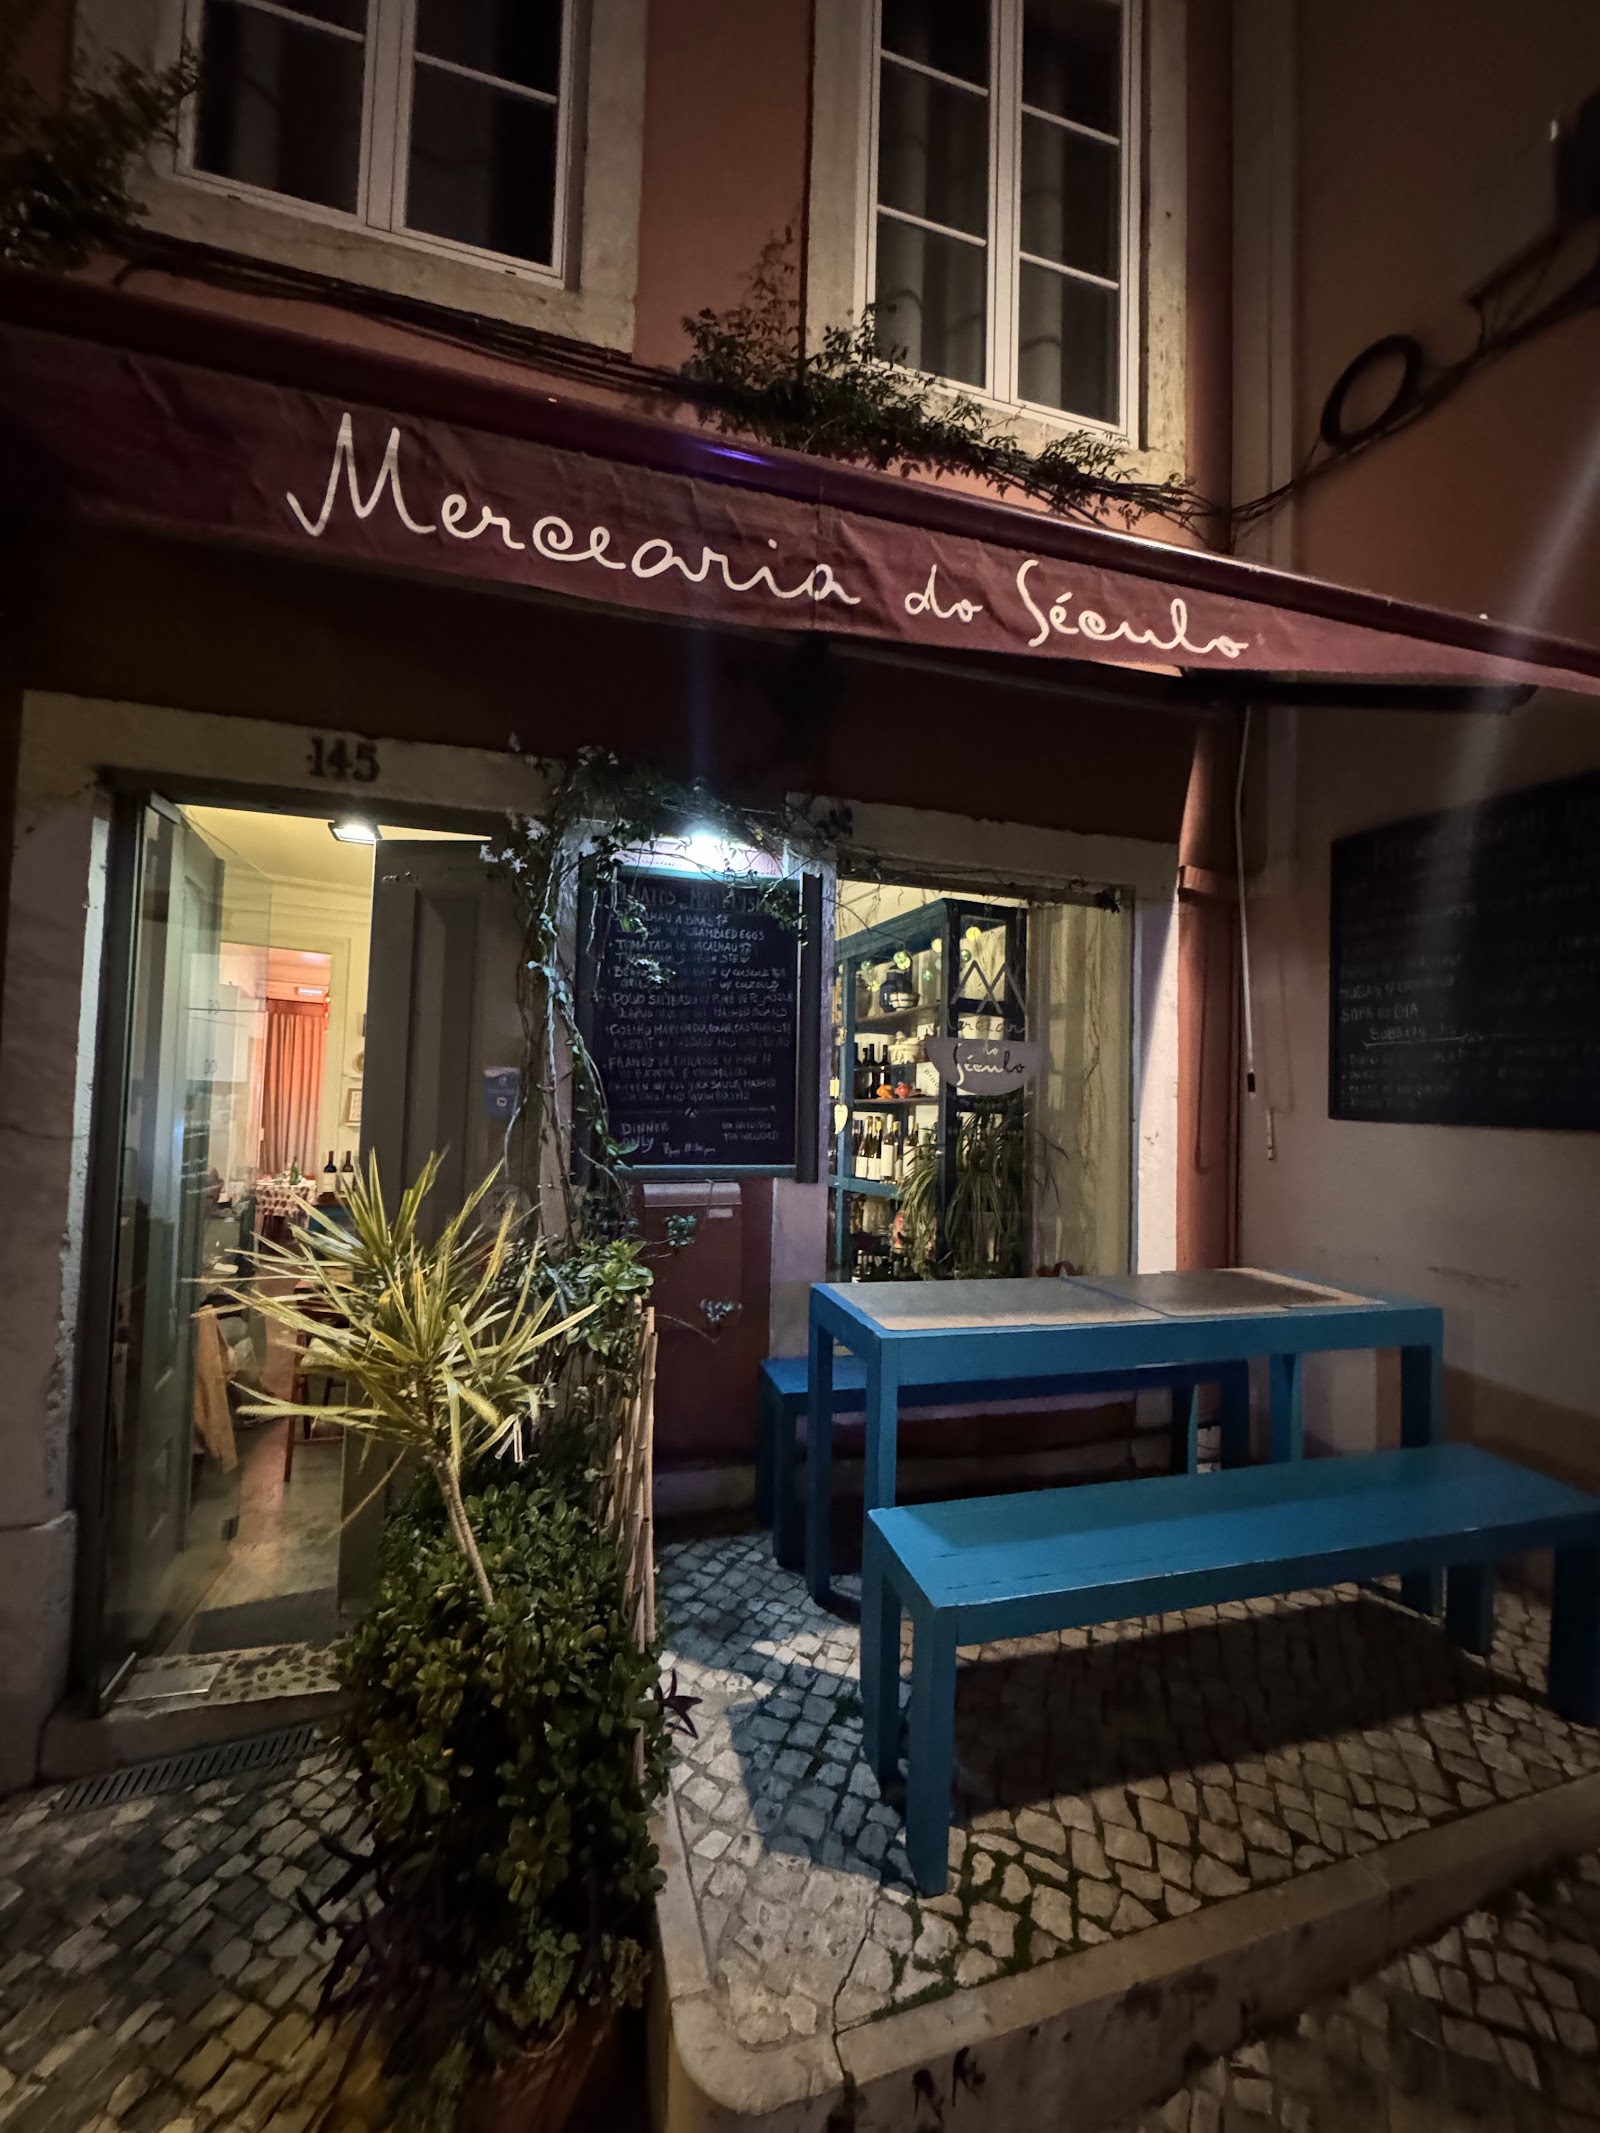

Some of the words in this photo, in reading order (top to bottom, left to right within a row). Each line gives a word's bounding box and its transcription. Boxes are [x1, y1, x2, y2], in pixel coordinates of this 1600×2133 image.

[286, 412, 861, 606] Mercearia
[903, 563, 979, 624] do
[1015, 558, 1250, 660] Século
[308, 735, 381, 783] 145
[738, 929, 765, 942] EGGS
[620, 1120, 669, 1136] DINNER
